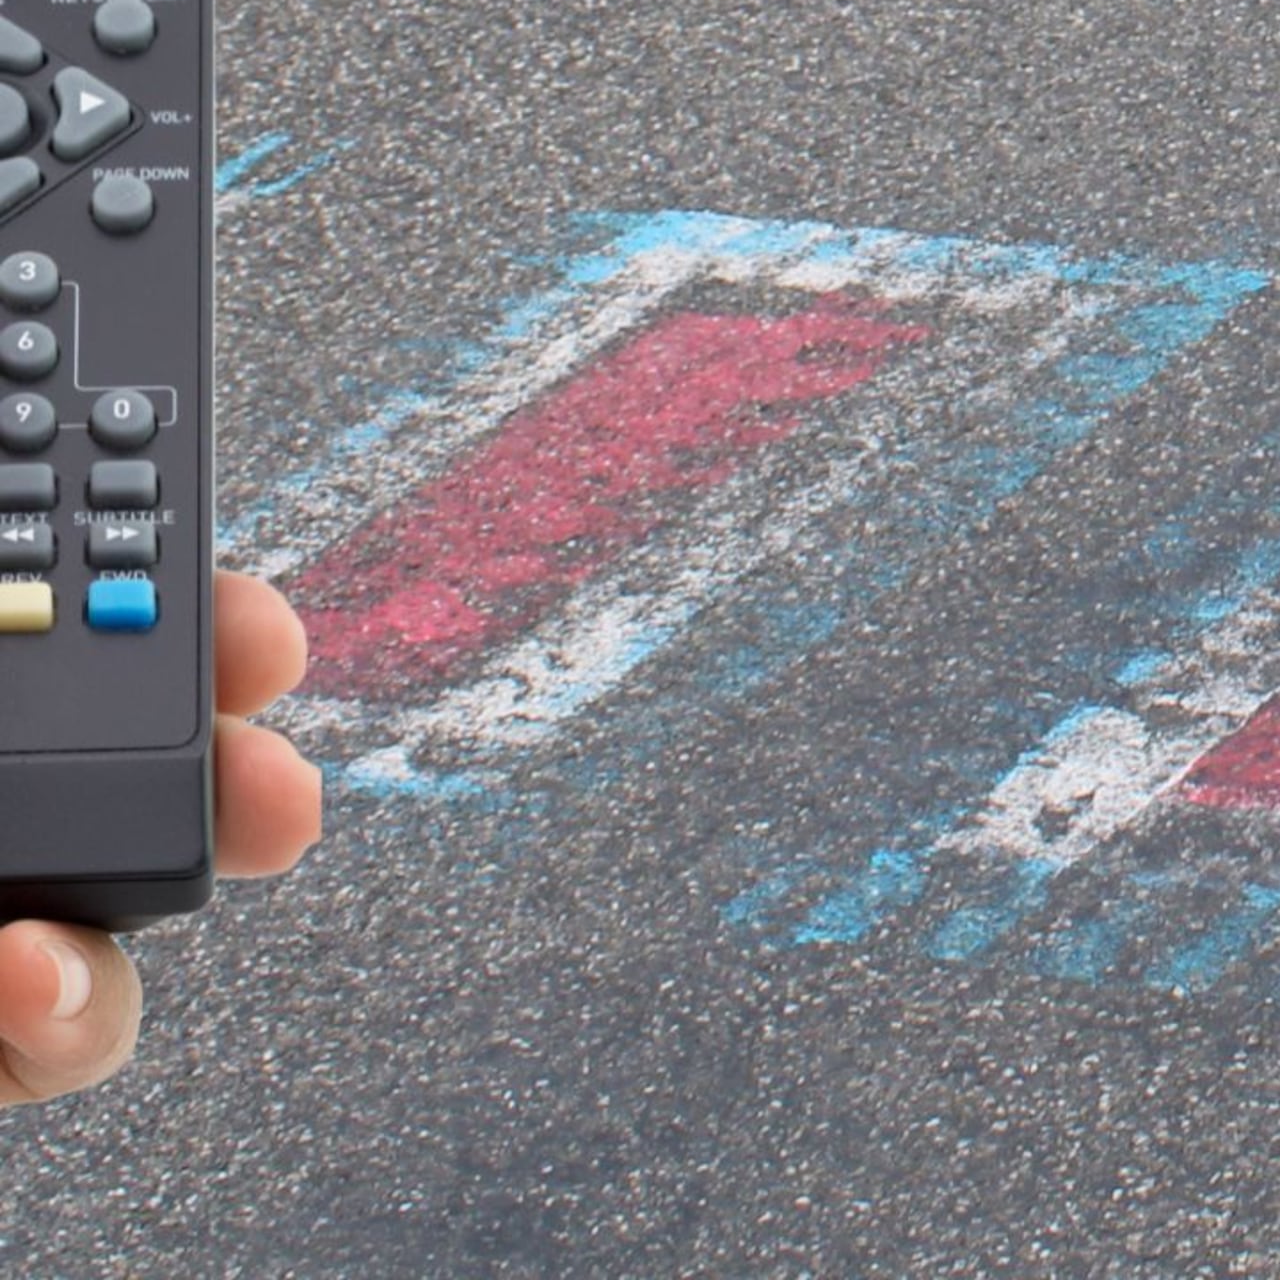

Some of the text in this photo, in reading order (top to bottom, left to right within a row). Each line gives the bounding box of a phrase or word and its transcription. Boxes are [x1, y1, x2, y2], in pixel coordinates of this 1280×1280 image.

[139, 166, 189, 181] DOWN
[19, 260, 36, 281] 3
[17, 330, 34, 350] 6
[15, 398, 131, 423] 9 0
